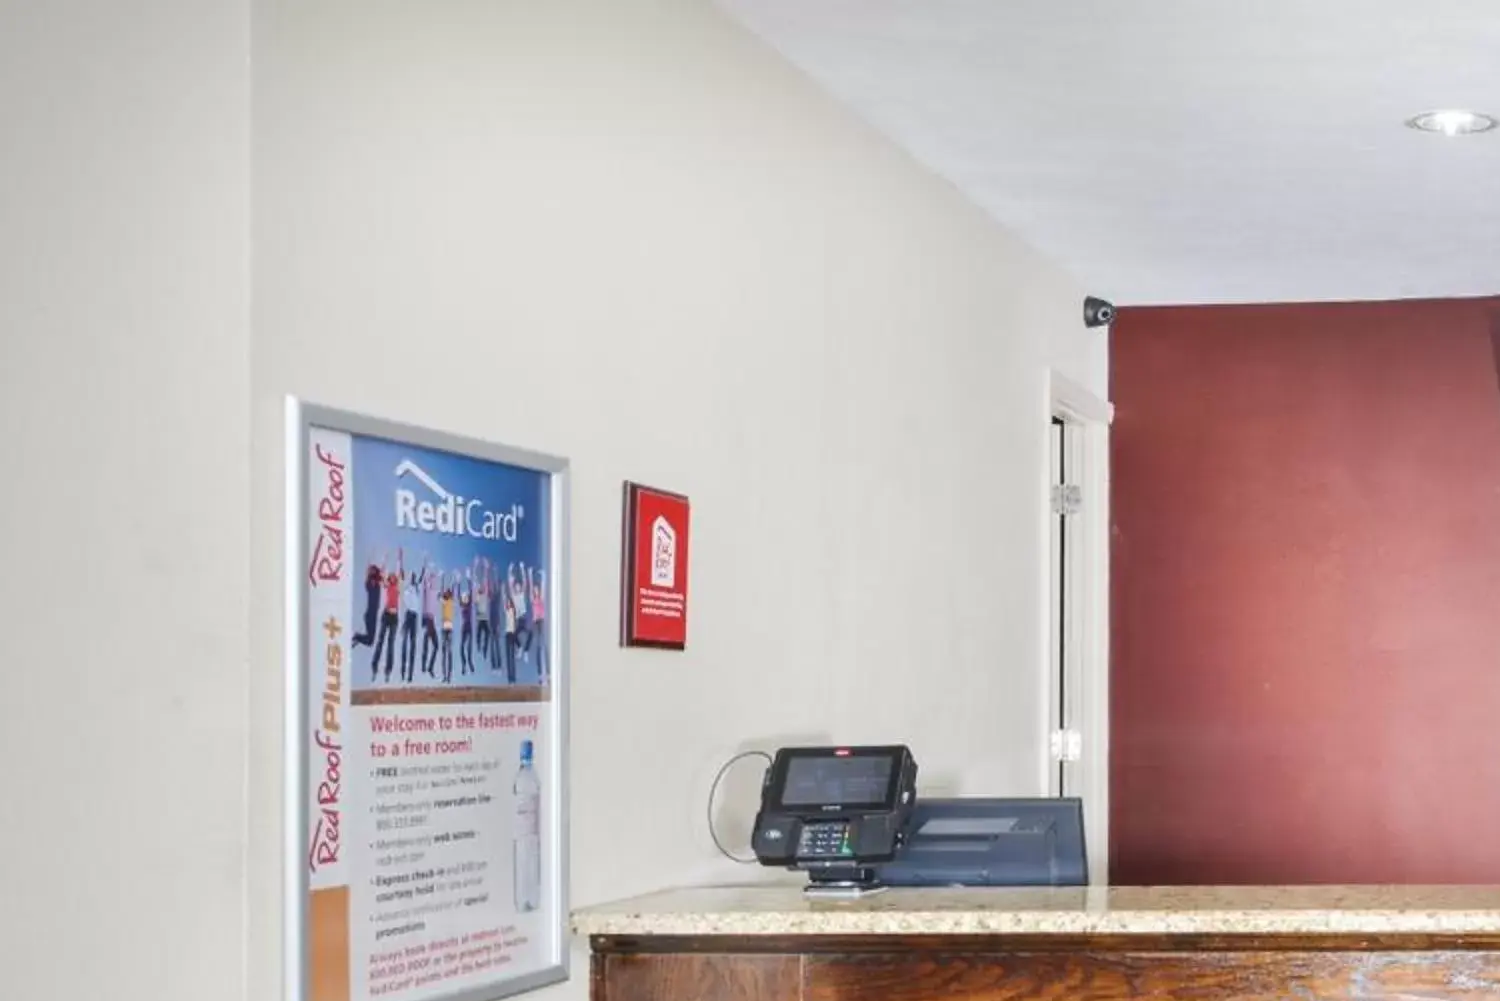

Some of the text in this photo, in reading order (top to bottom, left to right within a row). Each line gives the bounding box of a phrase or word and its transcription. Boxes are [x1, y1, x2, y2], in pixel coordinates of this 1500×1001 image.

[315, 443, 345, 581] Red Roof
[369, 712, 539, 733] Welcome to the fastest way
[315, 730, 342, 805] Roof
[369, 741, 386, 758] to
[391, 743, 400, 757] a
[404, 738, 431, 756] free
[375, 766, 398, 777] FREE
[317, 808, 340, 865] Red
